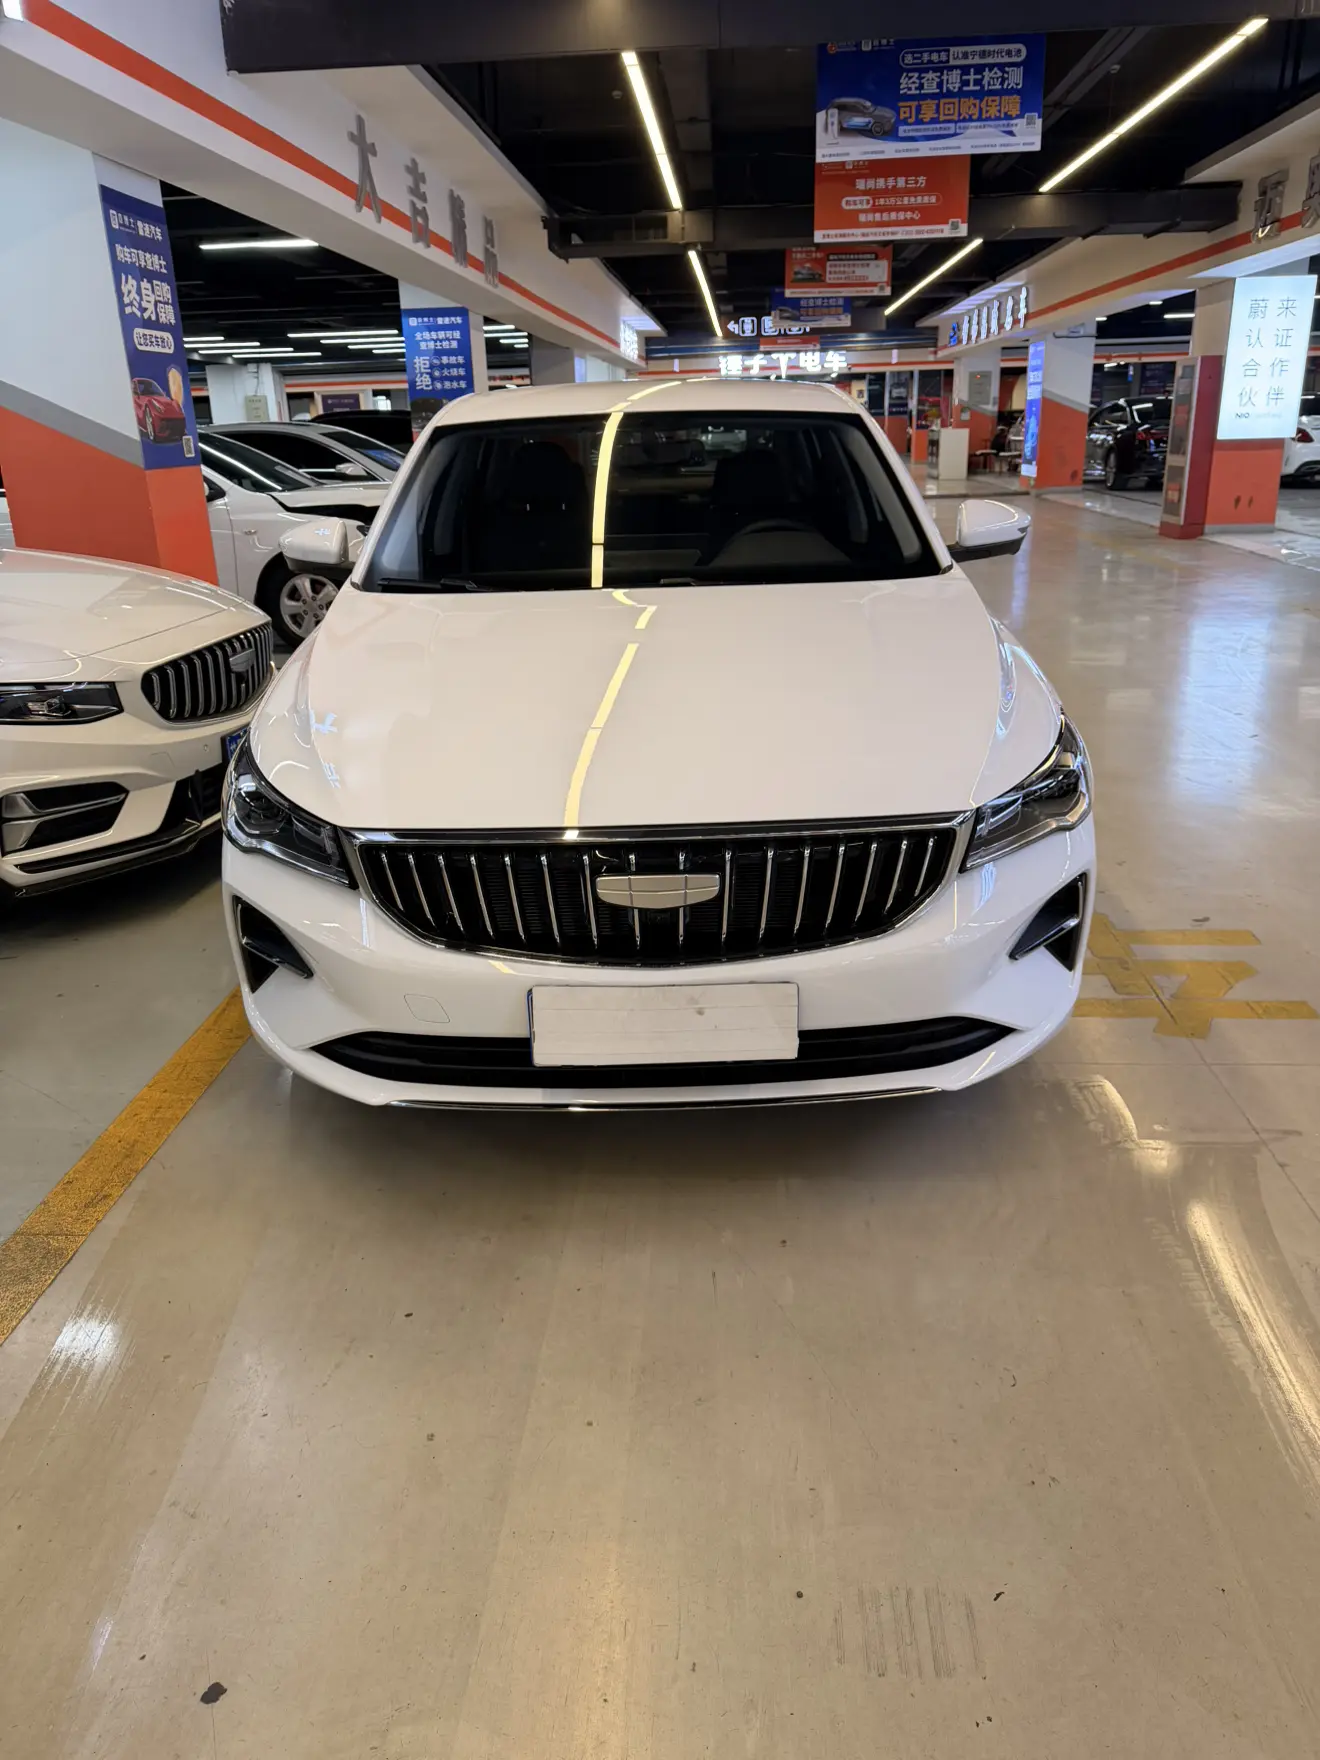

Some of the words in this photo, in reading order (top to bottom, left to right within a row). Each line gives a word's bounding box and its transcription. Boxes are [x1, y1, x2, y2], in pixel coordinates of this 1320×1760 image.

[899, 66, 1024, 95] 经查博士检测
[898, 95, 1021, 124] 可享回购保障
[115, 243, 168, 275] 购车可享查博士
[121, 272, 157, 322] 终身
[153, 279, 172, 304] 回购
[157, 303, 176, 326] 保障
[1247, 296, 1297, 320] 蔚来
[135, 331, 173, 350] 让您买车放心
[419, 340, 459, 350] 查博士检测
[1245, 327, 1294, 349] 认证
[441, 356, 466, 365] 事故车
[1242, 356, 1290, 378] 合作
[413, 356, 433, 390] 拒绝
[442, 368, 467, 377] 火烧车
[443, 380, 468, 390] 泡水车
[1237, 384, 1286, 408] 伙伴
